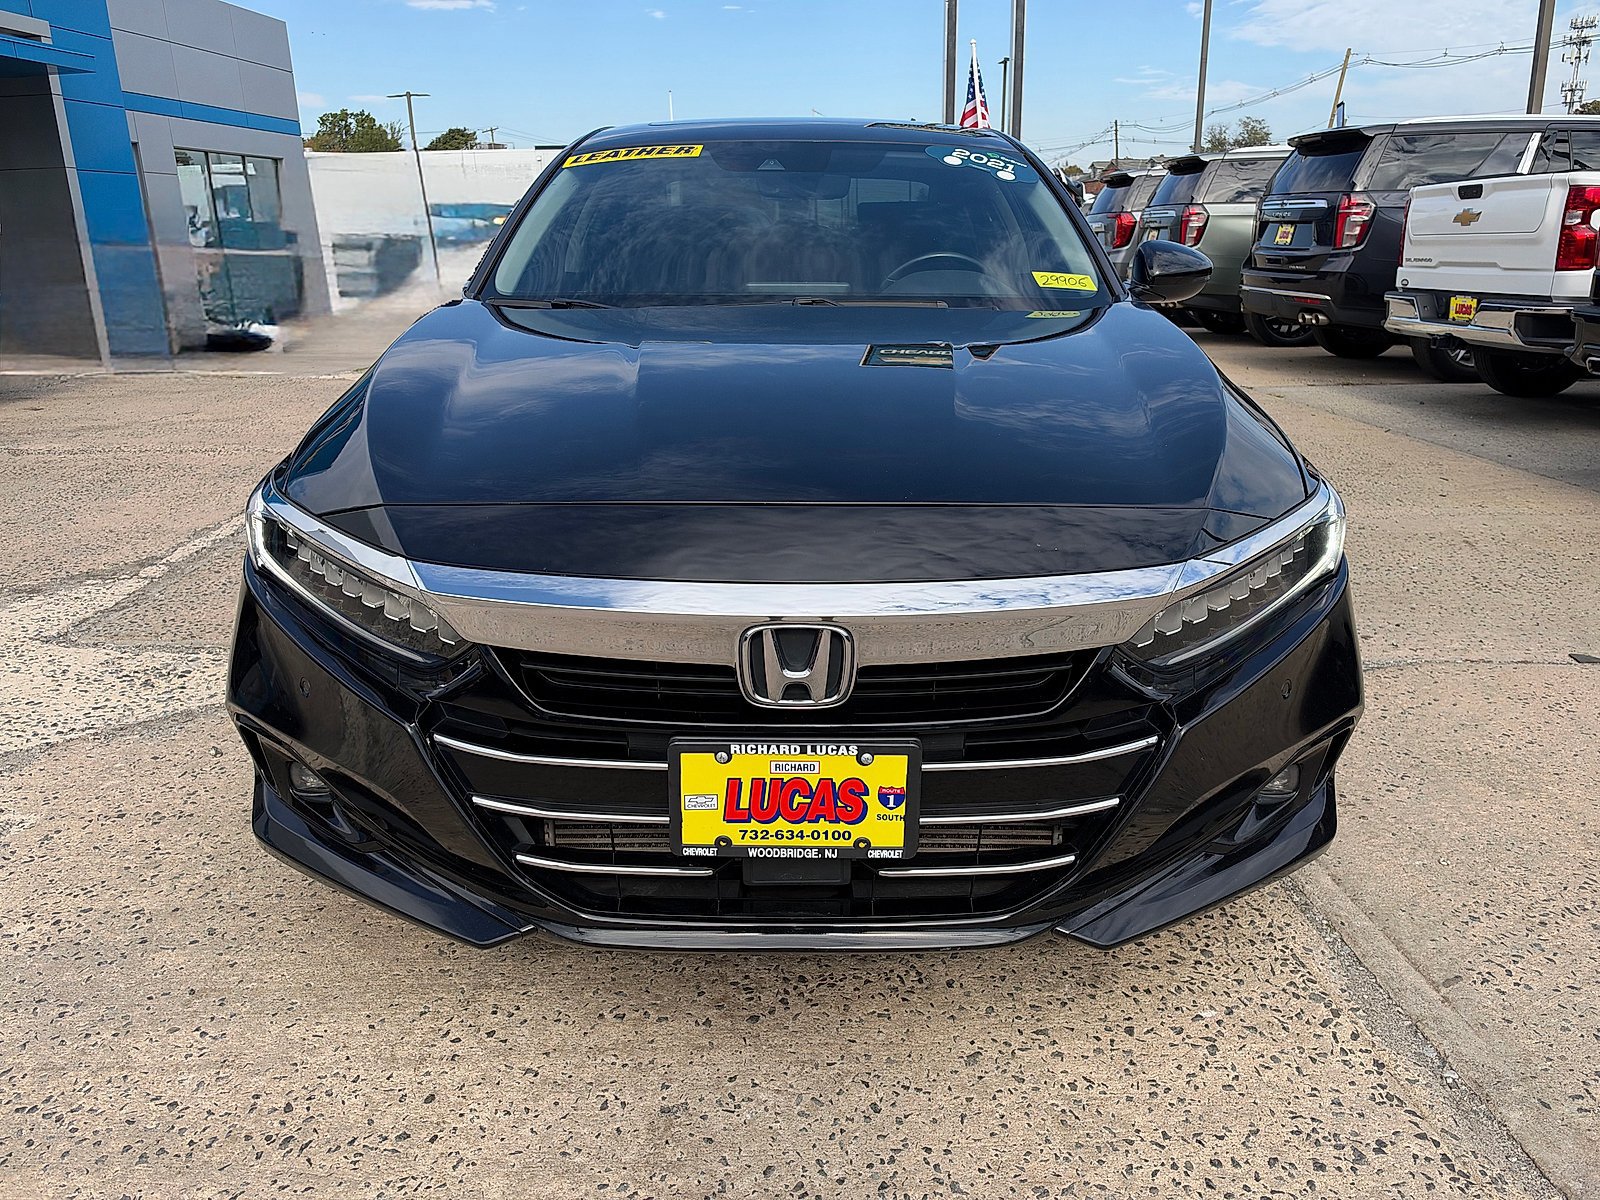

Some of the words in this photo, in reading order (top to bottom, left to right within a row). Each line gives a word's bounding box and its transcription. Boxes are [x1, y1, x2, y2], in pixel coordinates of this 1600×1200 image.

[569, 145, 695, 164] LEATHER
[951, 148, 1015, 174] 2021
[1040, 275, 1088, 287] 29906
[730, 744, 801, 755] RICHARD
[807, 745, 858, 756] LUCAS
[774, 763, 816, 772] RICHARD
[723, 777, 870, 825] LUCAS
[886, 795, 897, 808] 1
[739, 829, 852, 841] 732-634-0100
[682, 847, 718, 856] CHEVROLET
[748, 847, 822, 858] WOODBRIDGE,
[825, 848, 838, 858] NJ
[867, 849, 904, 858] CHEVROLET
